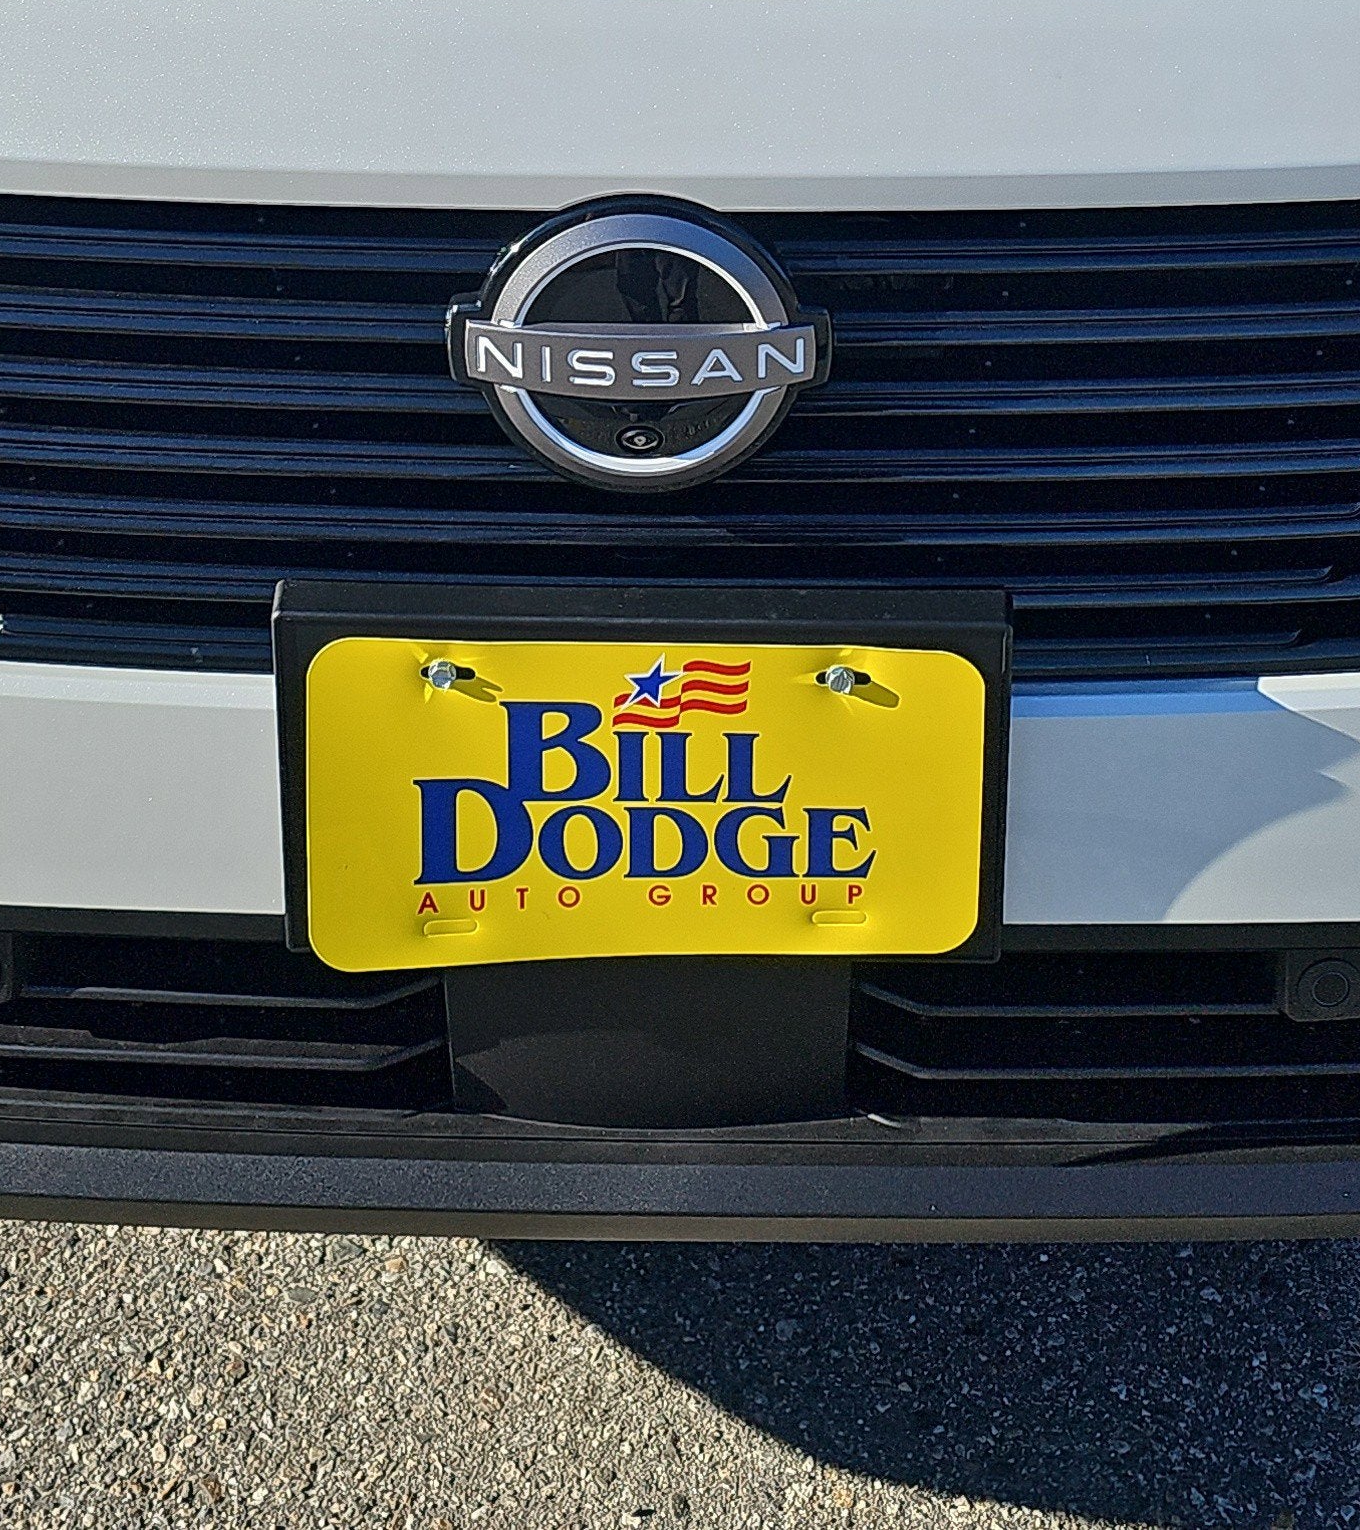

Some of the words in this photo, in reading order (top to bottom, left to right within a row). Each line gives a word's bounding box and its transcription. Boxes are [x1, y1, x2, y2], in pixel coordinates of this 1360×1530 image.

[474, 335, 807, 388] NISSAN
[498, 700, 792, 804] BILL
[413, 778, 877, 886] DODGE
[418, 886, 582, 916] AUTO
[647, 883, 864, 908] GROUP
